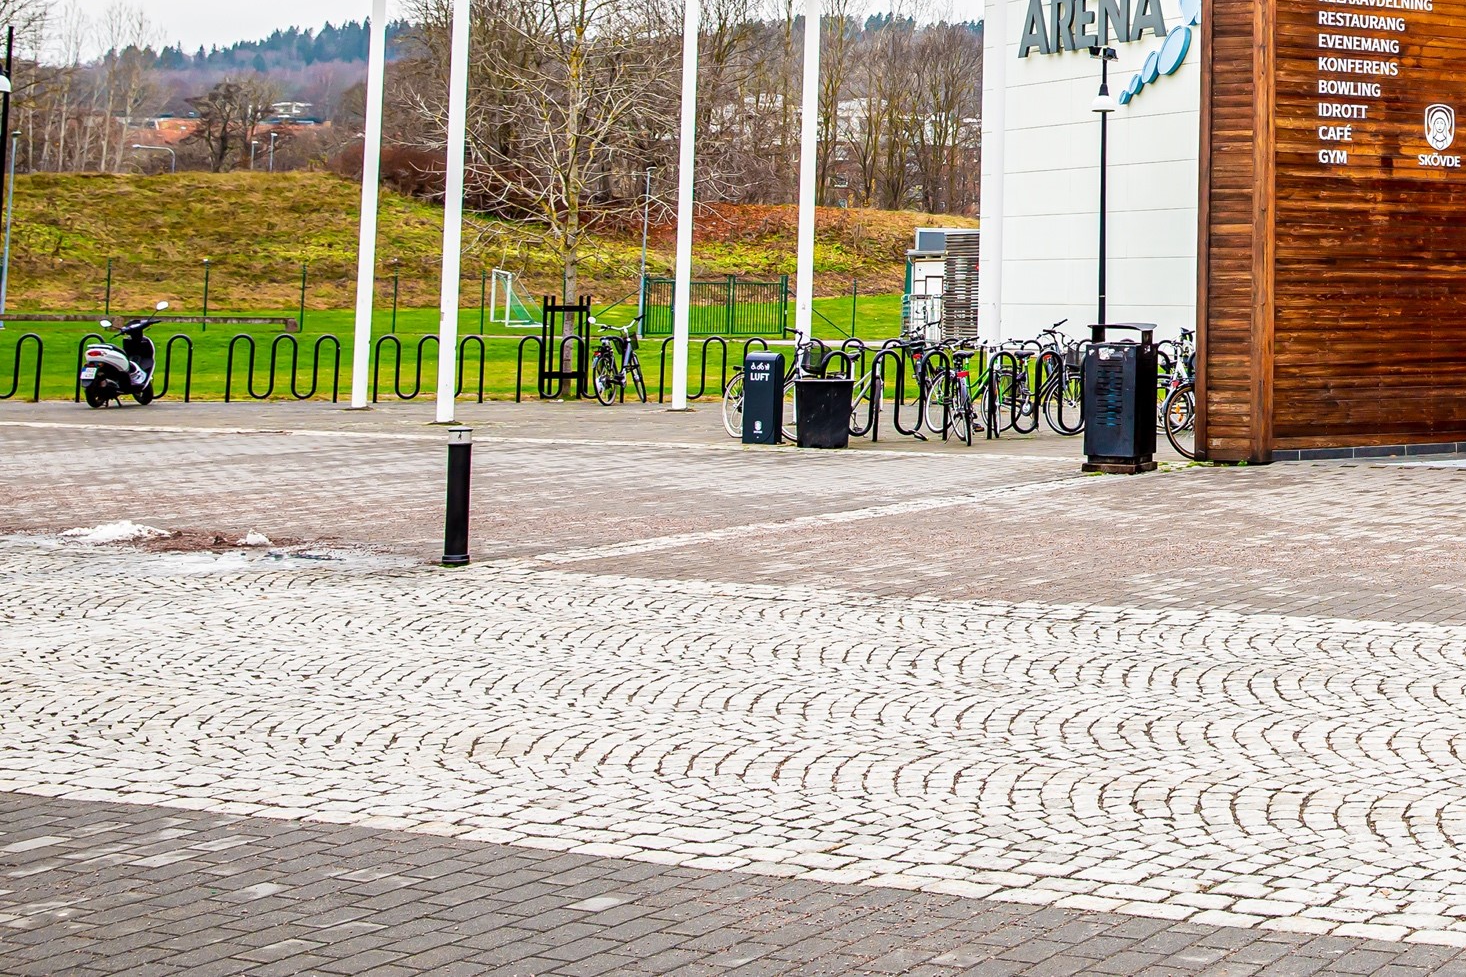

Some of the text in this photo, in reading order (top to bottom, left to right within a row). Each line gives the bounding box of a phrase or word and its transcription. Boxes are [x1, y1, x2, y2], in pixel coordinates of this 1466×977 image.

[1318, 10, 1406, 32] RESTAURANG
[1318, 33, 1400, 54] EVENEMANG
[1318, 56, 1399, 76] KONFERENS
[1318, 79, 1381, 97] BOWLING
[1318, 102, 1369, 119] IDROTT
[1318, 124, 1353, 141] CAFÉ
[1318, 149, 1348, 164] GYM
[1418, 152, 1461, 168] SKÖVDE
[750, 372, 770, 382] LUFT
